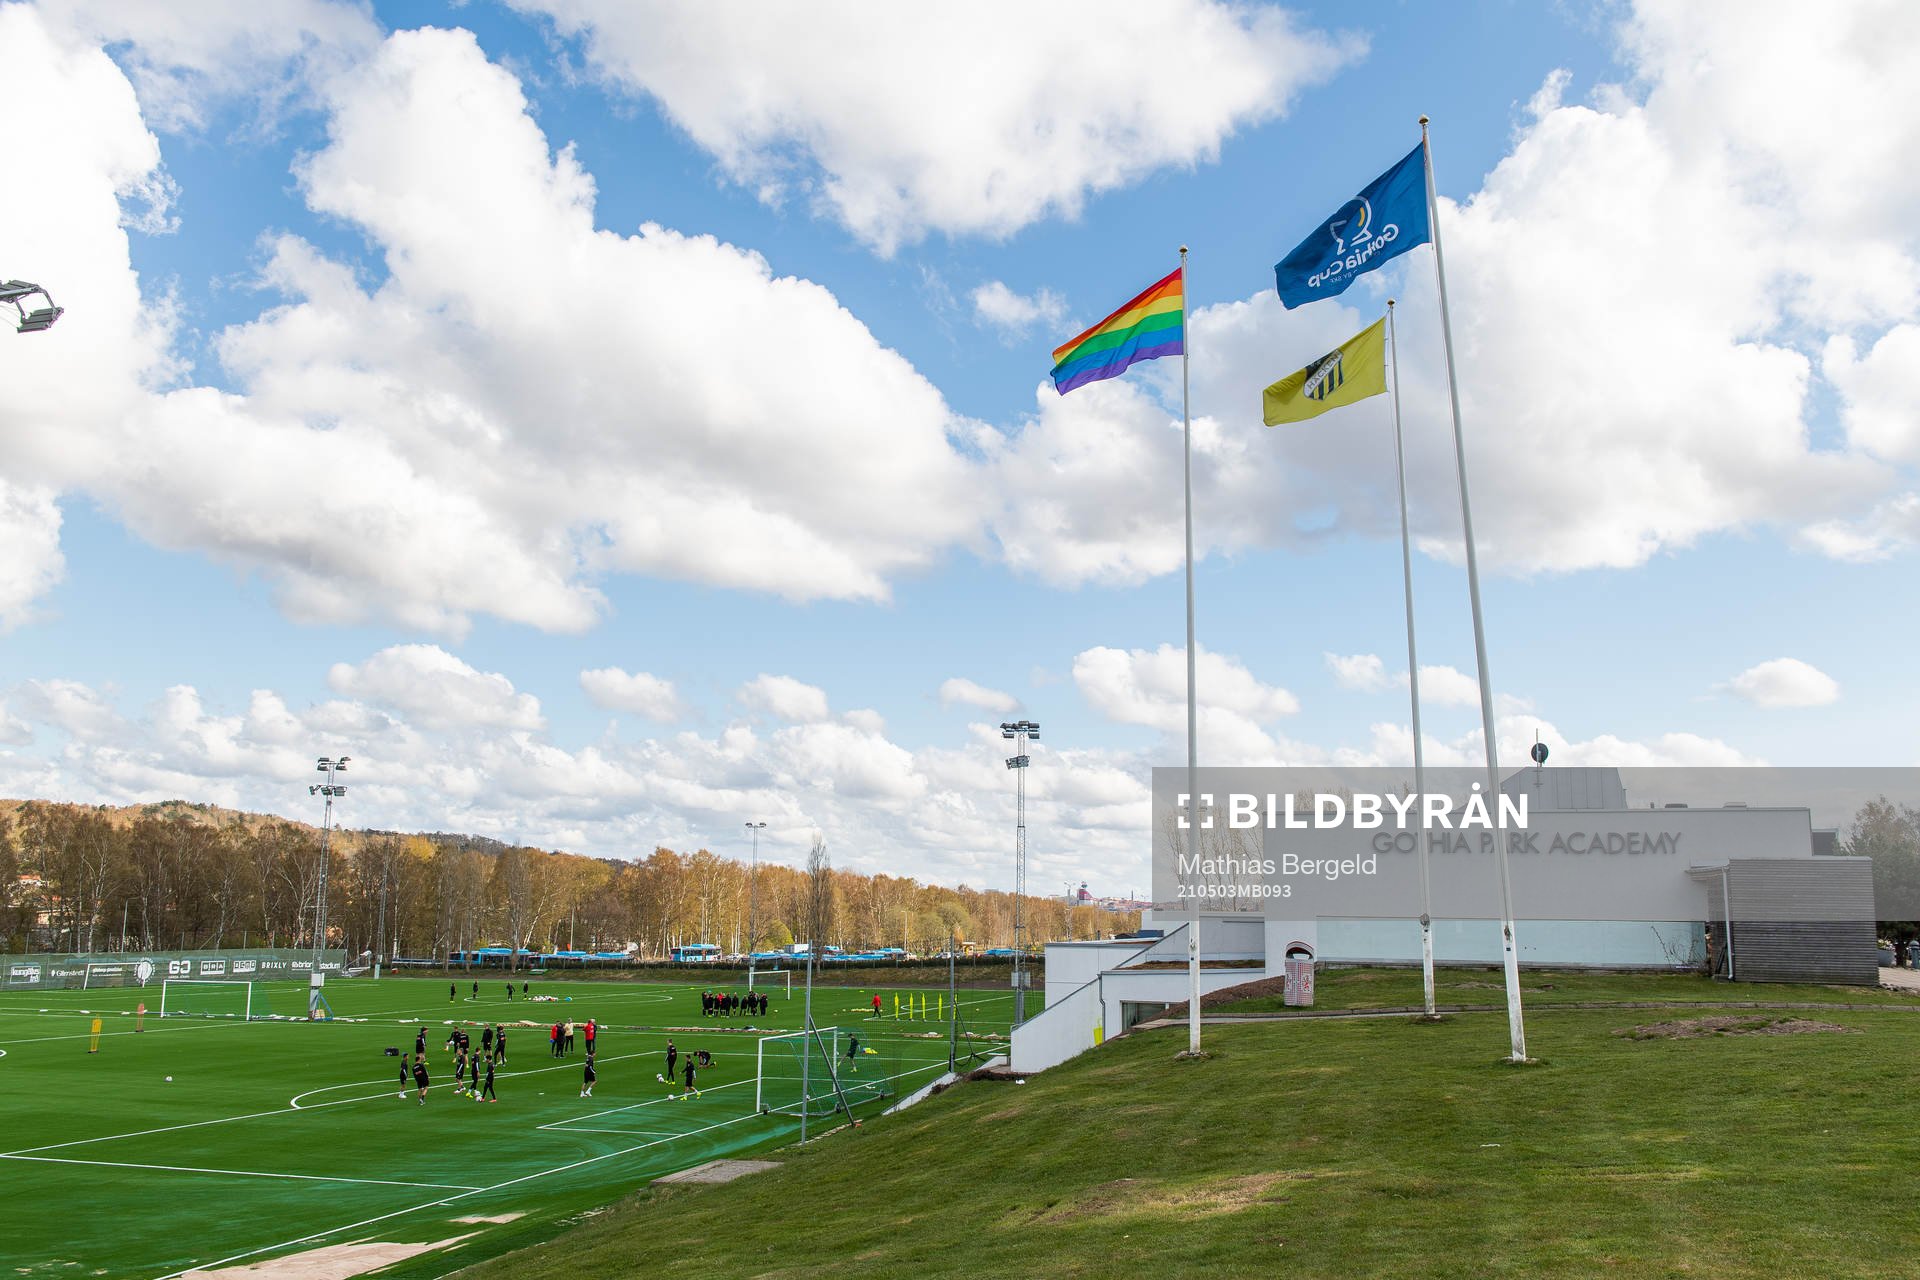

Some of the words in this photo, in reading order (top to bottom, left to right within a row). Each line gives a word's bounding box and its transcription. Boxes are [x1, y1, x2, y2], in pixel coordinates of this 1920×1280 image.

[1372, 831, 1471, 854] GOHIA
[1480, 831, 1540, 854] PRK
[1548, 831, 1682, 855] ACADEMY
[261, 961, 288, 969] BRIXLY
